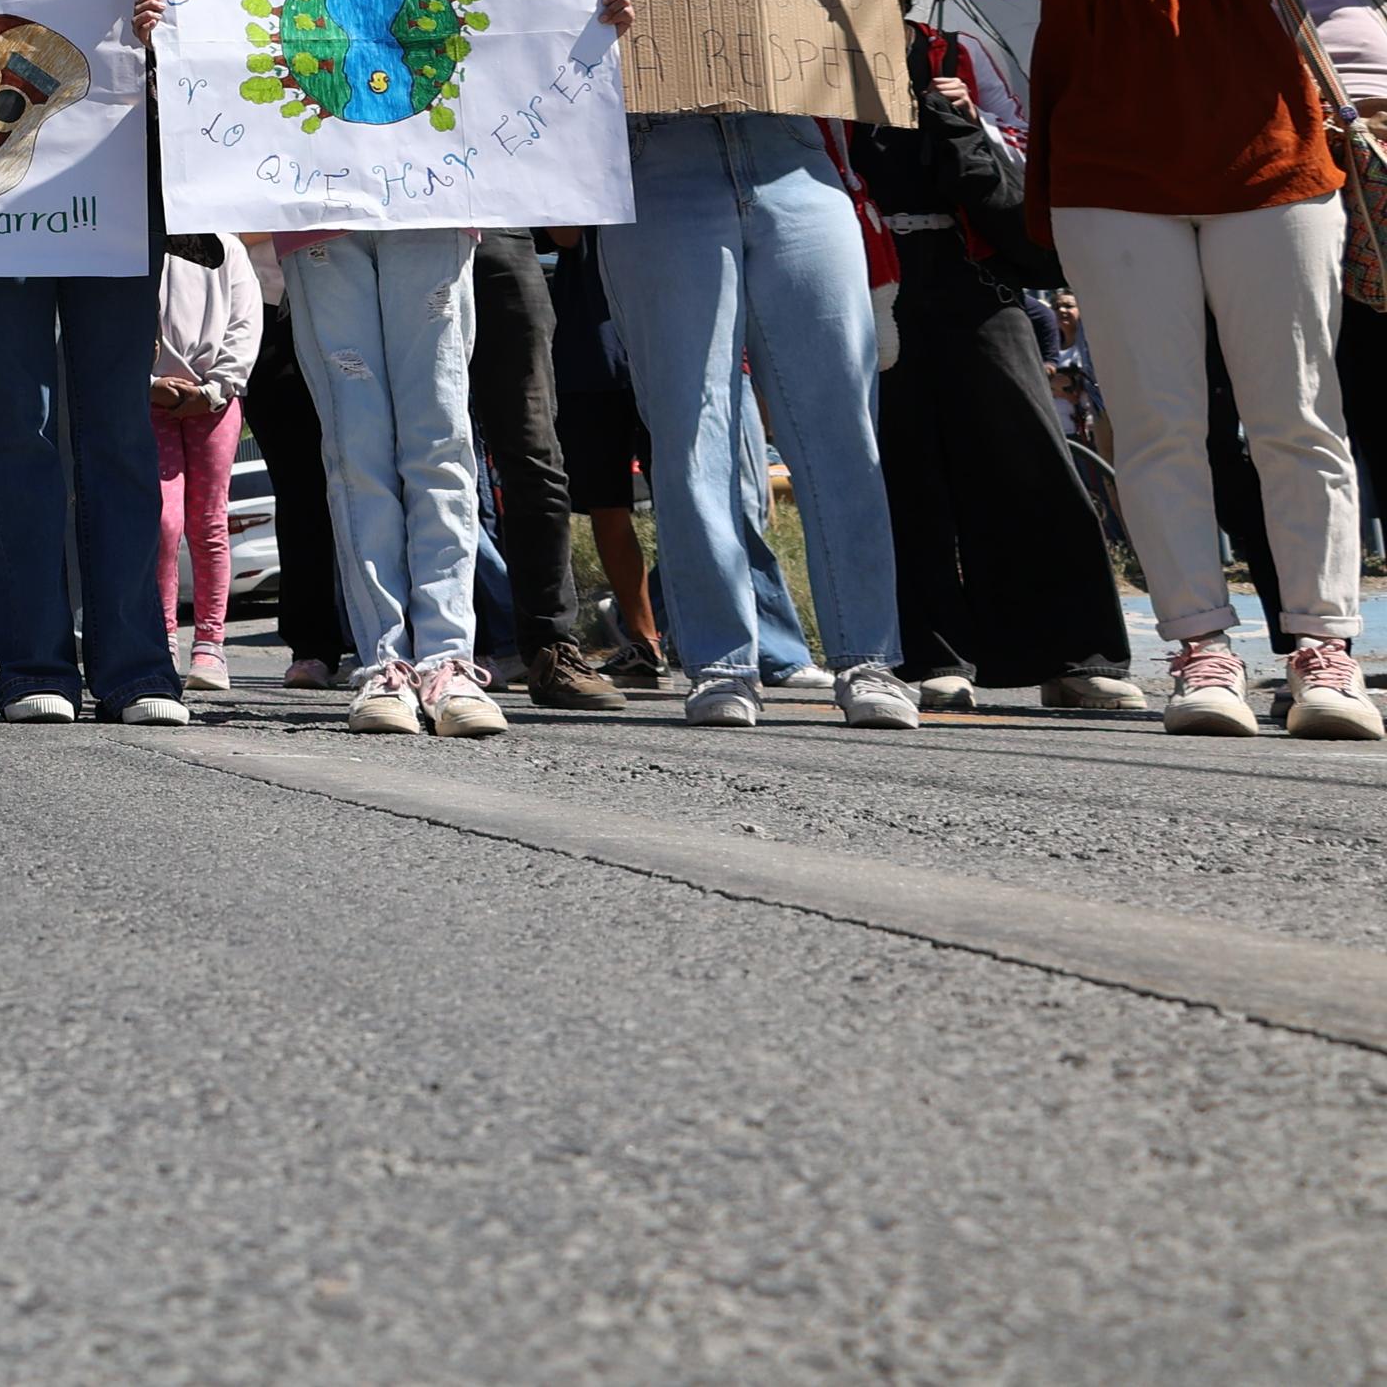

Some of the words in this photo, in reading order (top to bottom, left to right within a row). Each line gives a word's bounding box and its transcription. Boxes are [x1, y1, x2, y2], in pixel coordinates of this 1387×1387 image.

[703, 28, 899, 96] RESPETA
[257, 154, 352, 209] QUE
[373, 146, 479, 207] HAY
[490, 95, 545, 157] EN
